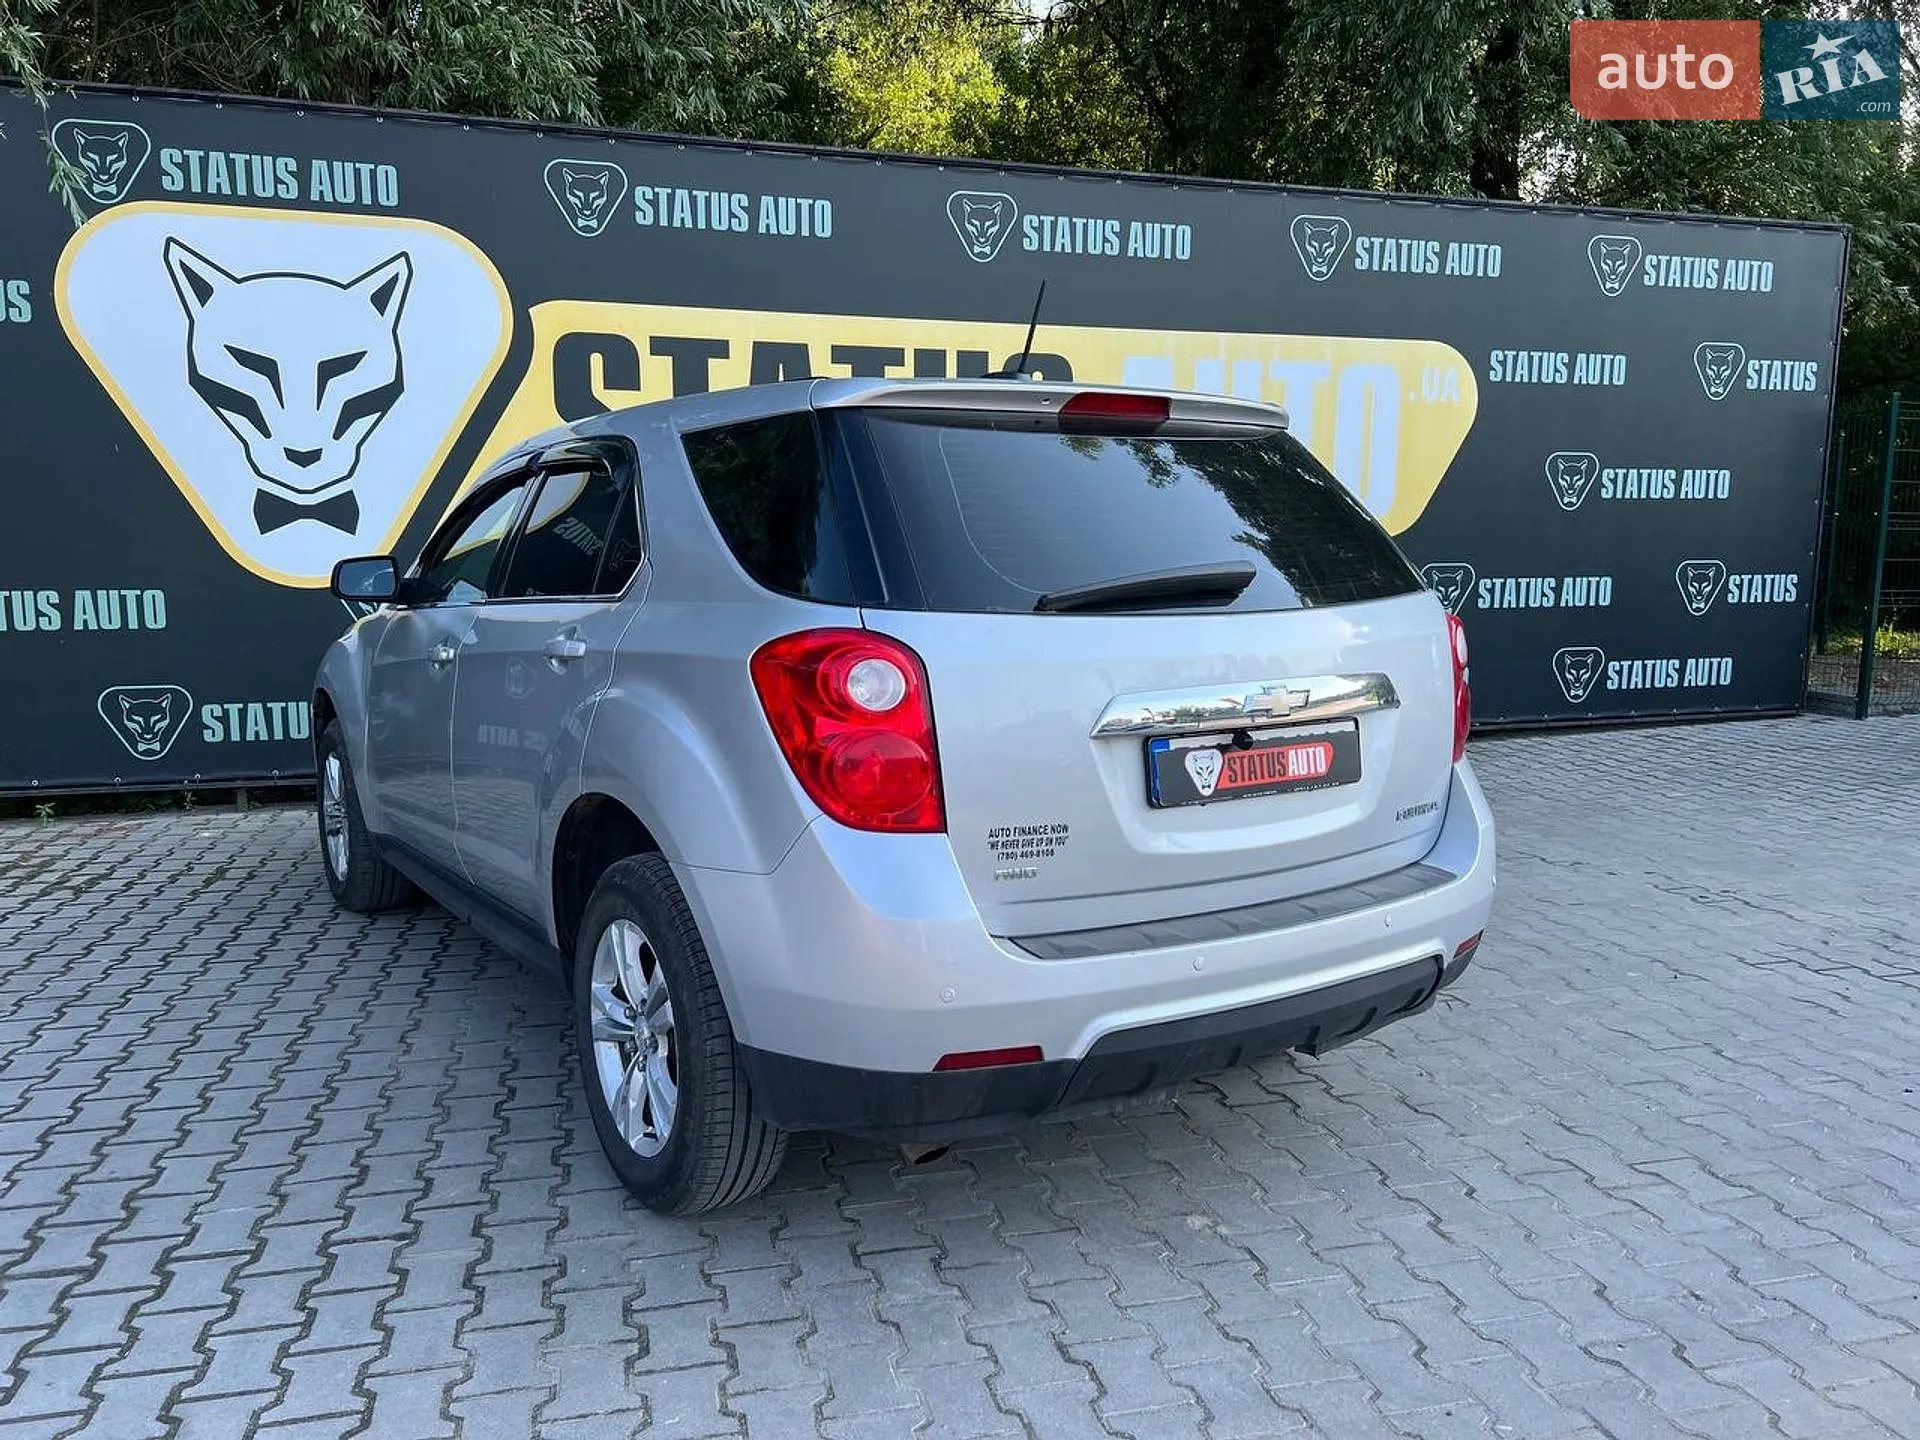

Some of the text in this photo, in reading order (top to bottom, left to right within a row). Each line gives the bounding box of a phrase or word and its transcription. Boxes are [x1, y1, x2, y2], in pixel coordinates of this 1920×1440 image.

[160, 148, 400, 207] STATUS AUTO
[634, 185, 833, 239] STATUS AUTO
[1022, 214, 1193, 260] STATUS AUTO
[1354, 236, 1502, 278] STATUS AUTO
[1643, 254, 1774, 293] STATUS AUTO
[0, 279, 32, 323] S
[1489, 349, 1627, 386] STATUS AUTO
[1746, 359, 1818, 392] STATUS
[1601, 468, 1731, 500] STATUS AUTO
[1478, 576, 1613, 609] STATUS AUTO
[1727, 574, 1798, 604] STATUS
[73, 589, 167, 631] AUTO
[1606, 657, 1733, 690] STATUS AUTO
[201, 701, 313, 743] STATU
[1226, 746, 1327, 784] STATUS AUTO
[988, 827, 1011, 839] AUTO
[1013, 824, 1050, 838] FINANCE
